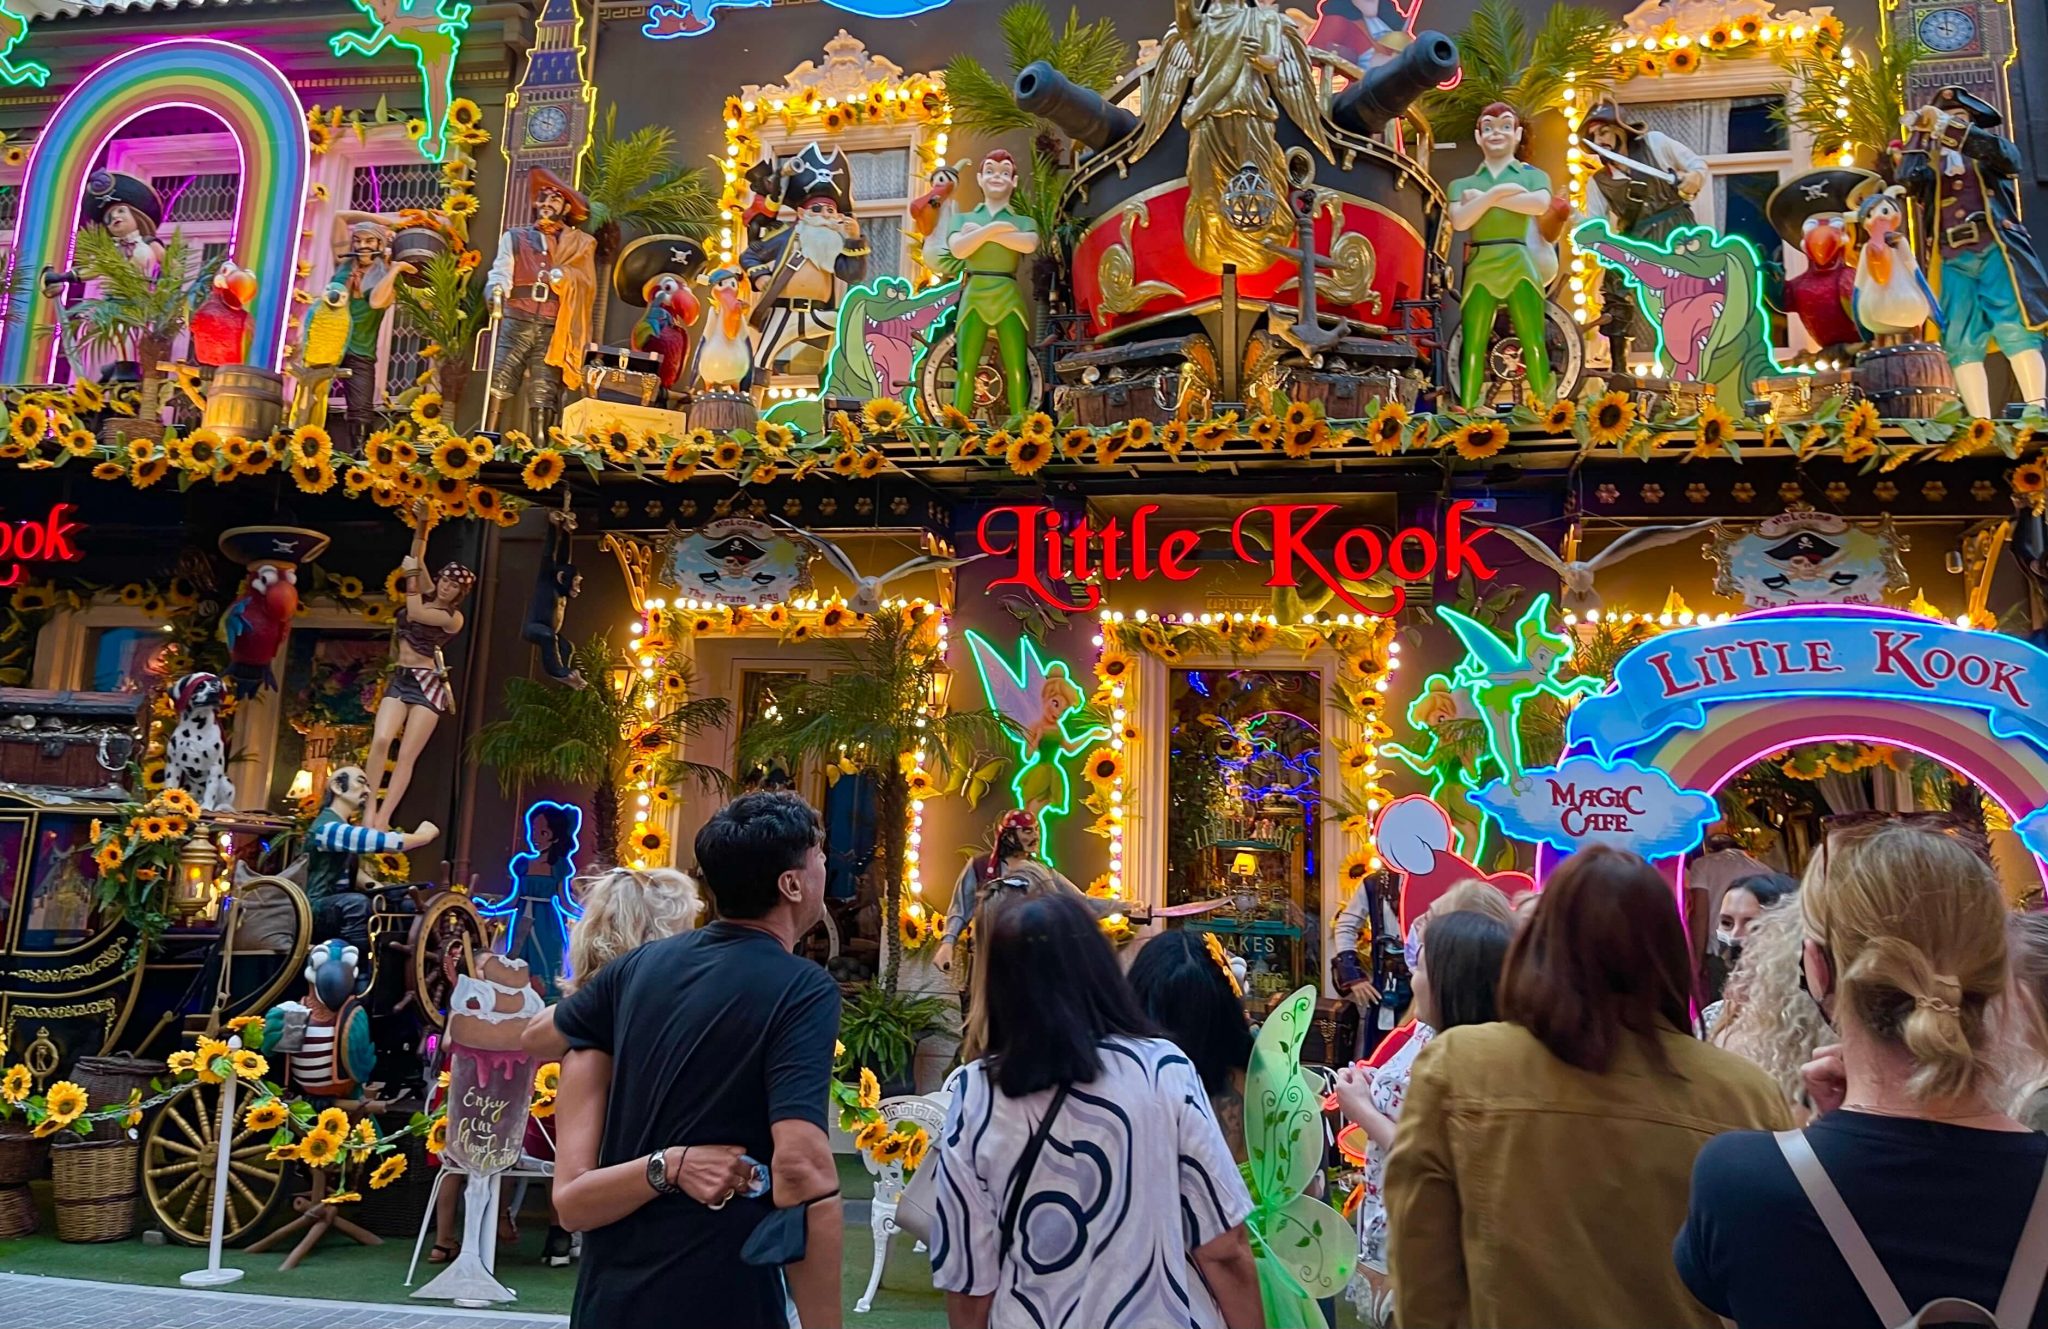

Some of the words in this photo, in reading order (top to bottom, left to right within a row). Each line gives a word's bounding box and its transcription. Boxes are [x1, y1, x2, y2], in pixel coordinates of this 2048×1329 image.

[976, 504, 1200, 611] Little
[1231, 500, 1498, 617] Kook
[688, 588, 707, 599] The
[714, 592, 747, 603] Pirate
[759, 592, 779, 603] Bay
[1755, 596, 1776, 608] The
[1843, 593, 1870, 604] Bay
[1647, 639, 1845, 698] LITTLE
[1871, 630, 2030, 708] KOOK
[1545, 778, 1646, 815] MAGIC
[1194, 819, 1251, 850] LITTLE
[1255, 822, 1295, 852] KOOK
[1561, 805, 1634, 837] CAFE
[1224, 863, 1263, 878] TEA
